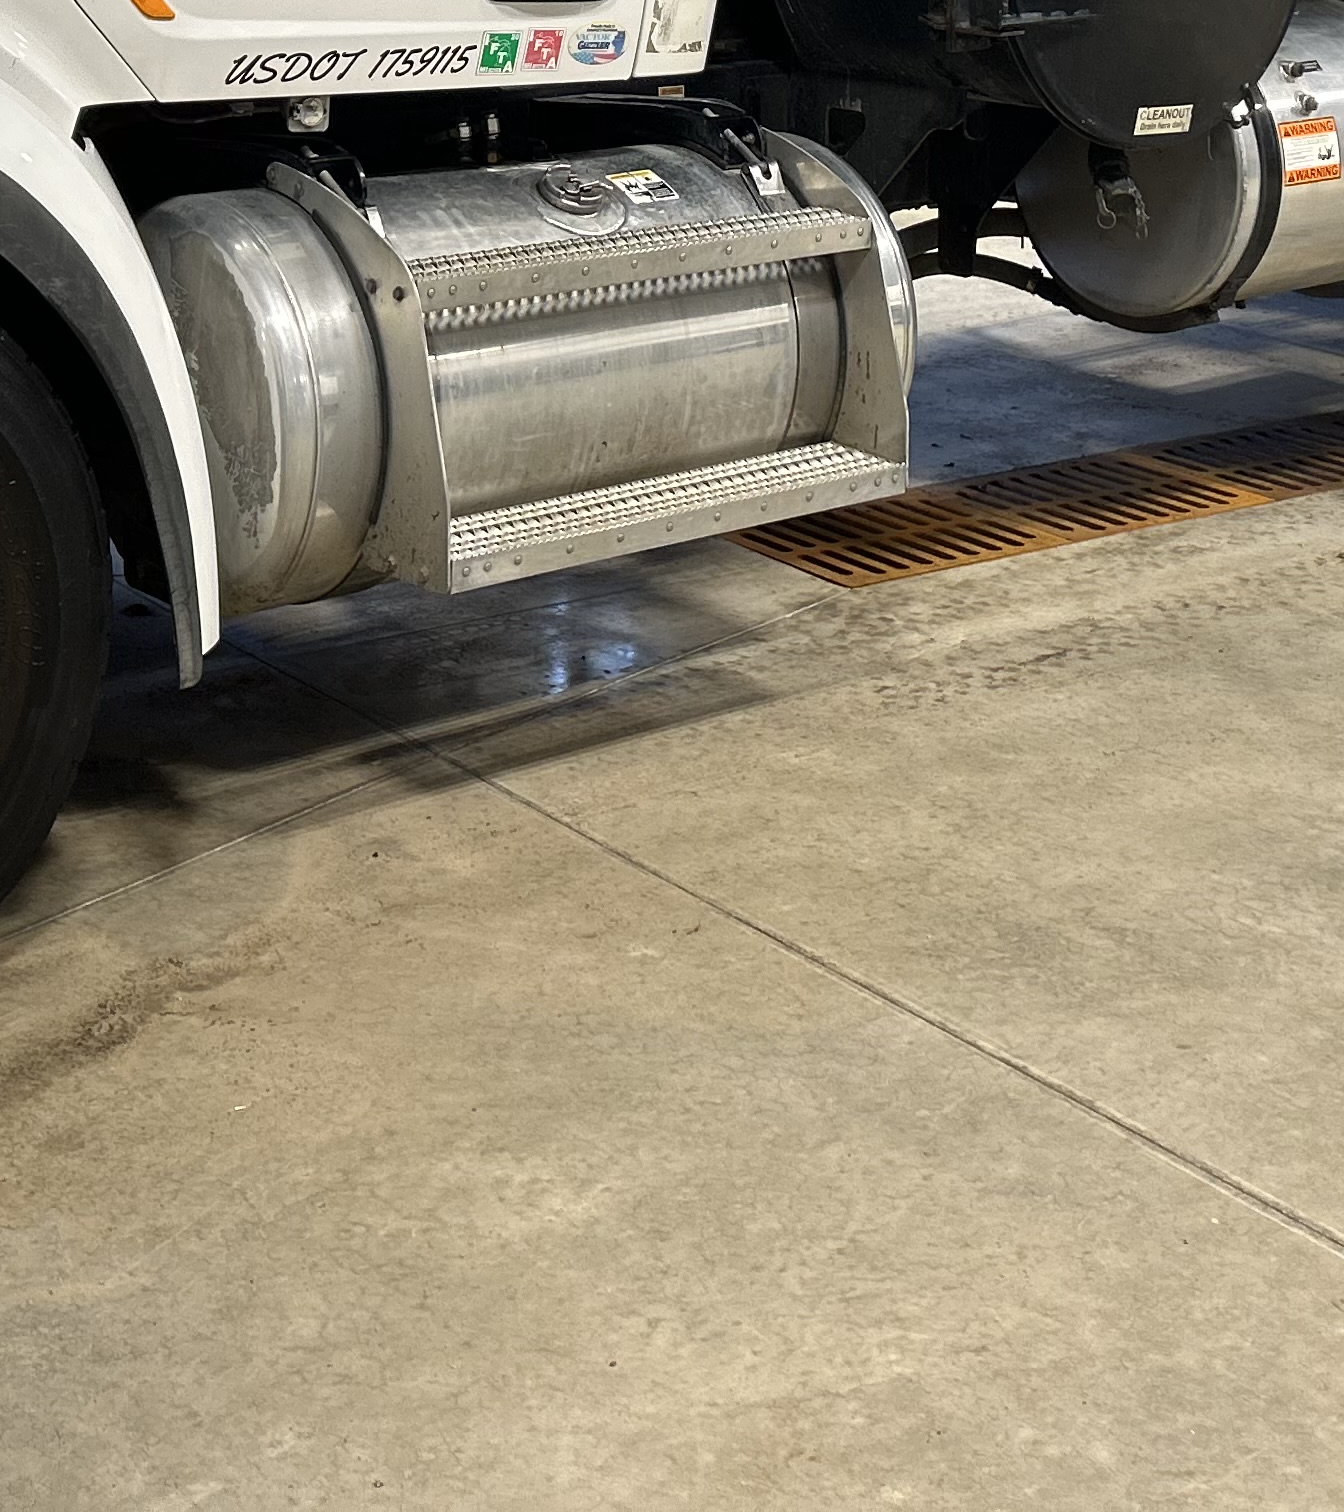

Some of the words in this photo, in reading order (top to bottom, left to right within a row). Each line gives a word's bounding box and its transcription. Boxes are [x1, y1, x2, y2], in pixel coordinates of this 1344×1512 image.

[225, 49, 368, 85] USDOT
[367, 45, 478, 78] 1759115
[1140, 107, 1192, 120] CLEANOUT
[1290, 119, 1336, 135] WARNING
[1294, 165, 1340, 182] WARNING
